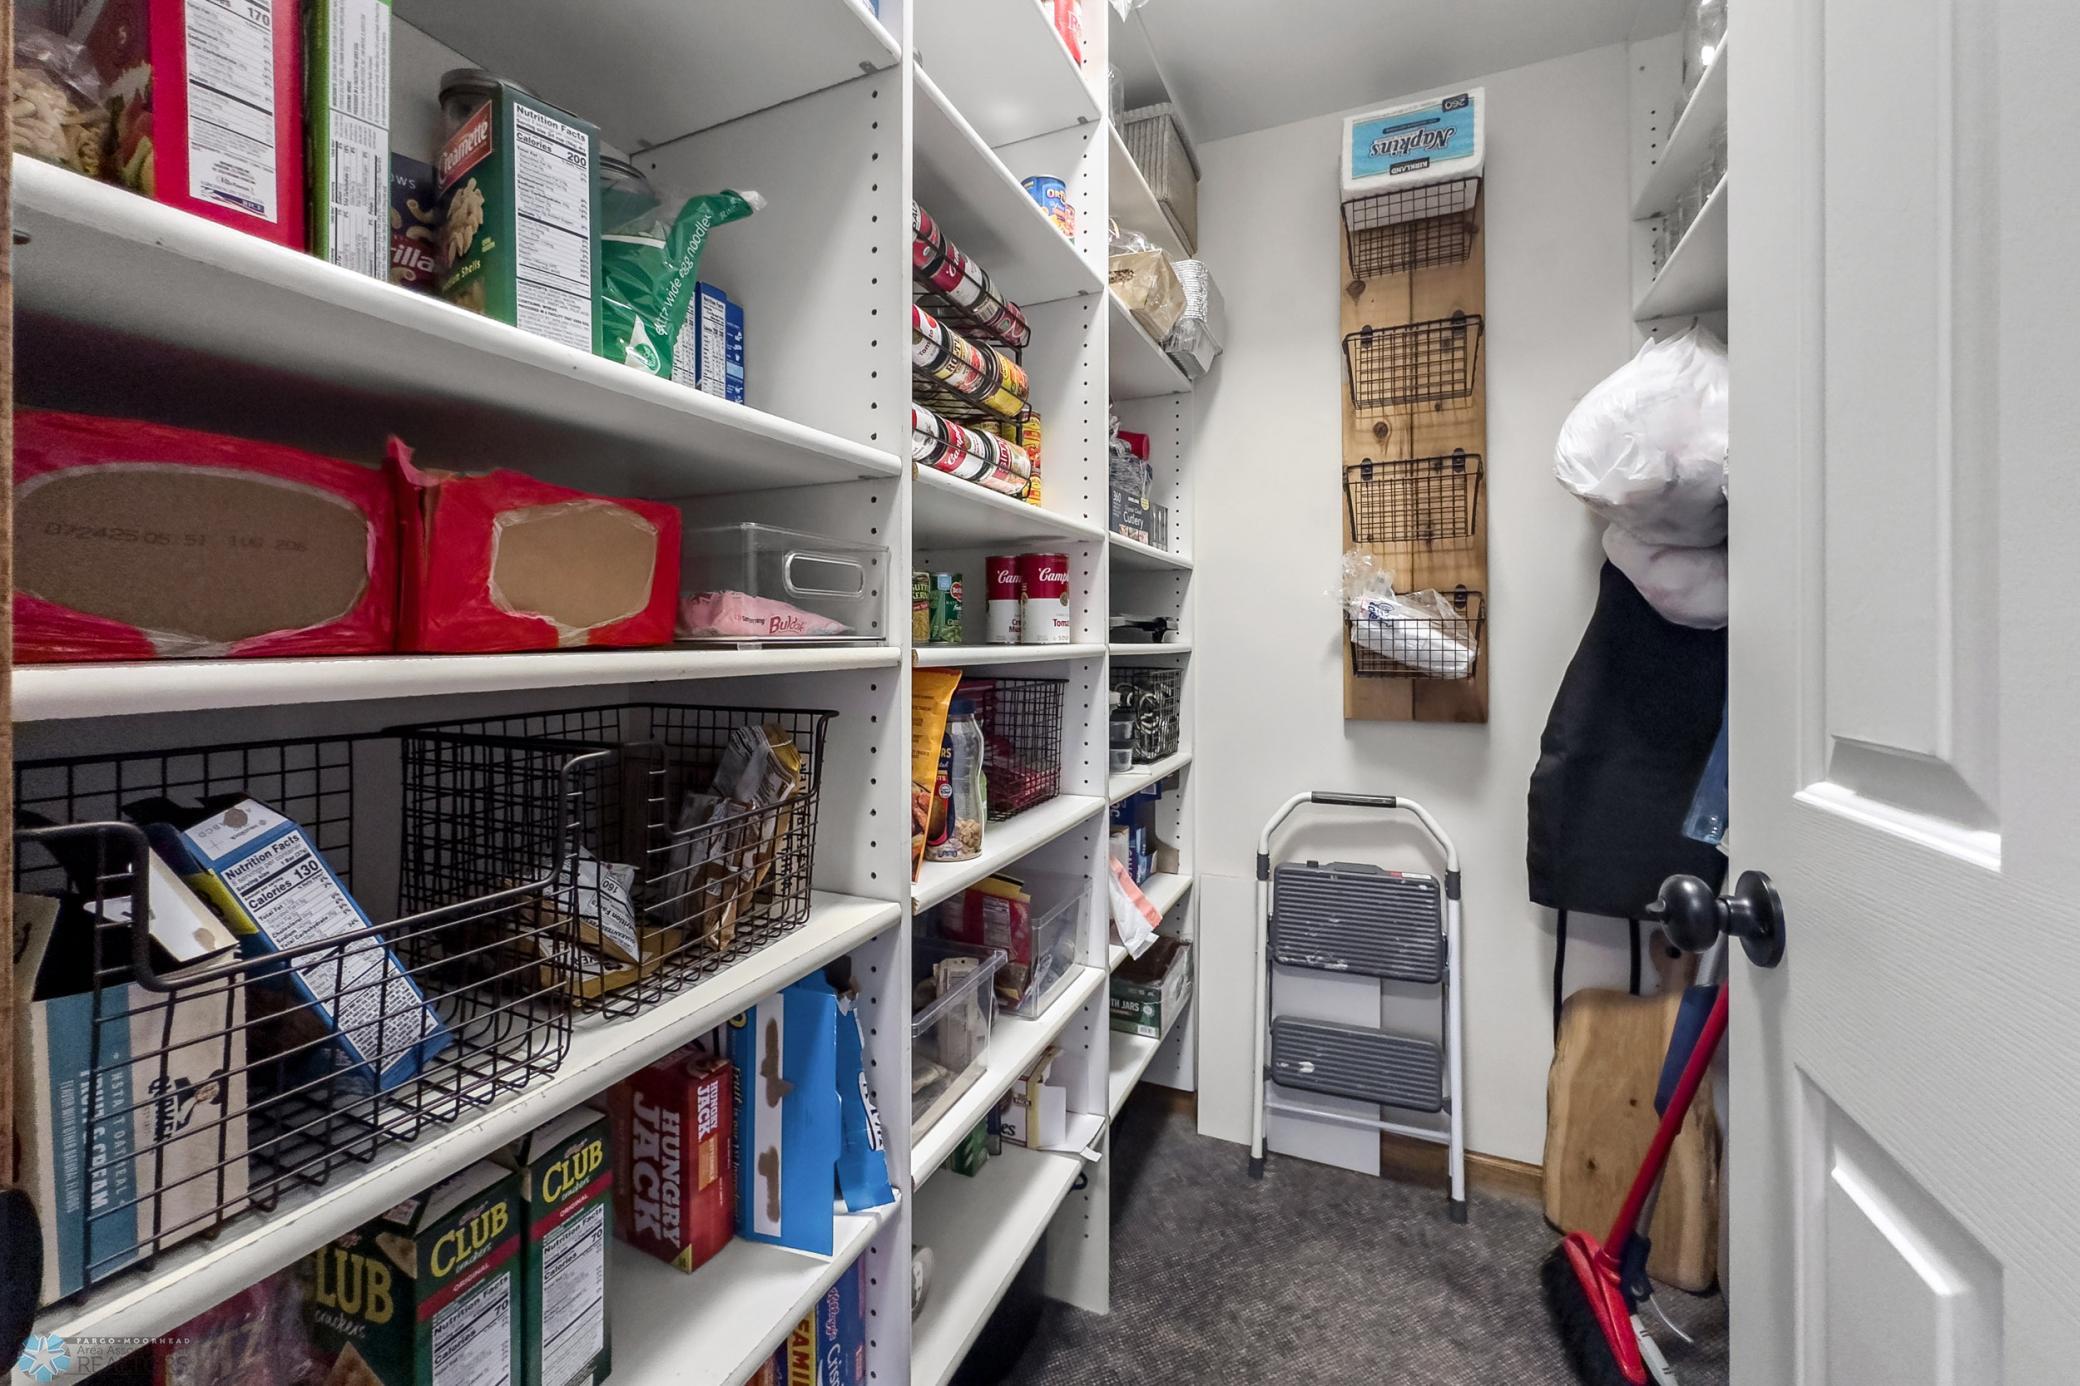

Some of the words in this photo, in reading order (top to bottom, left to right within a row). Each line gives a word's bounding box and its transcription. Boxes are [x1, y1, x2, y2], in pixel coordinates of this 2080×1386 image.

[248, 7, 270, 26] 170
[516, 105, 558, 130] Nutrition
[561, 125, 586, 142] Facts
[516, 132, 552, 153] Calories
[567, 152, 587, 167] 200
[1370, 127, 1456, 156] Napkins
[1391, 161, 1428, 174] KIRKLAND
[391, 246, 435, 273] illa
[664, 278, 682, 307] wide
[679, 256, 694, 279] egg
[919, 329, 934, 356] Tomto
[1123, 511, 1144, 530] Cutlery
[997, 569, 1022, 584] Cam
[1038, 567, 1070, 585] Camp
[224, 850, 272, 881] Nutrition
[271, 833, 300, 854] Facts
[248, 880, 293, 910] Calories
[293, 859, 320, 881] 130
[602, 880, 619, 894] 160
[1121, 1000, 1140, 1012] JARS
[697, 1084, 710, 1143] JACK
[710, 1080, 719, 1129] HUNGRY
[543, 1139, 603, 1203] CLUB
[632, 1091, 661, 1241] JACK
[661, 1108, 680, 1249] HUNGRY
[431, 1201, 509, 1278] CLUB
[544, 1224, 581, 1255] Nutrition
[591, 1228, 603, 1242] 70
[453, 1263, 491, 1292] ORIGINAL
[544, 1252, 577, 1280] Calories
[314, 1247, 395, 1324] LUB
[434, 1298, 481, 1336] Nutrition
[483, 1275, 509, 1299] Facts
[494, 1300, 509, 1316] 70
[434, 1329, 477, 1365] Calories
